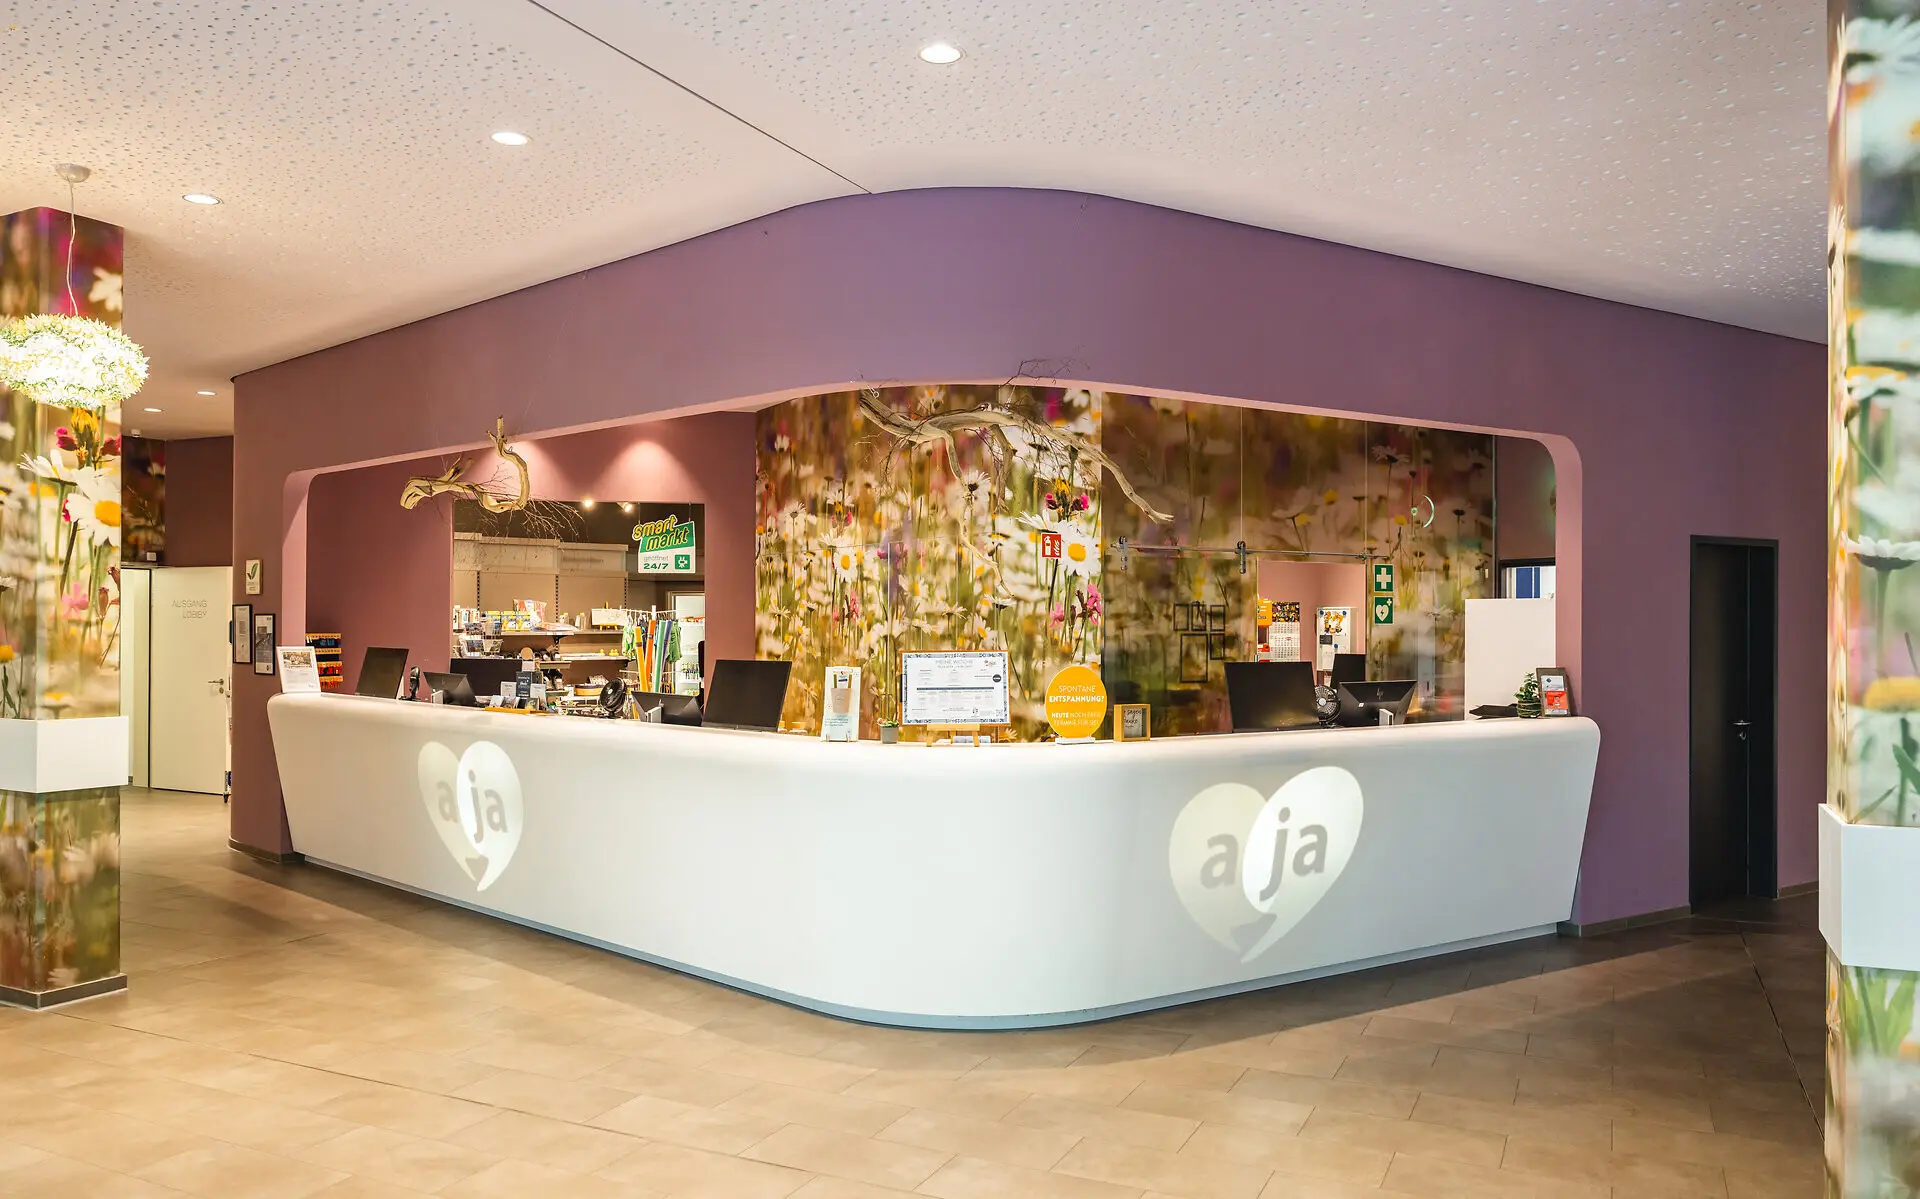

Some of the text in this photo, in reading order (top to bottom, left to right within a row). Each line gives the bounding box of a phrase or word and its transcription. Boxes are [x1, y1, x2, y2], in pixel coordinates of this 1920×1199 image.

[633, 515, 676, 540] smart
[646, 527, 689, 551] markt
[171, 599, 208, 608] AUSGANG
[182, 610, 208, 619] LOBBY
[1058, 685, 1096, 693] SPONTANE
[1049, 695, 1105, 703] ENTSPANNUNG?
